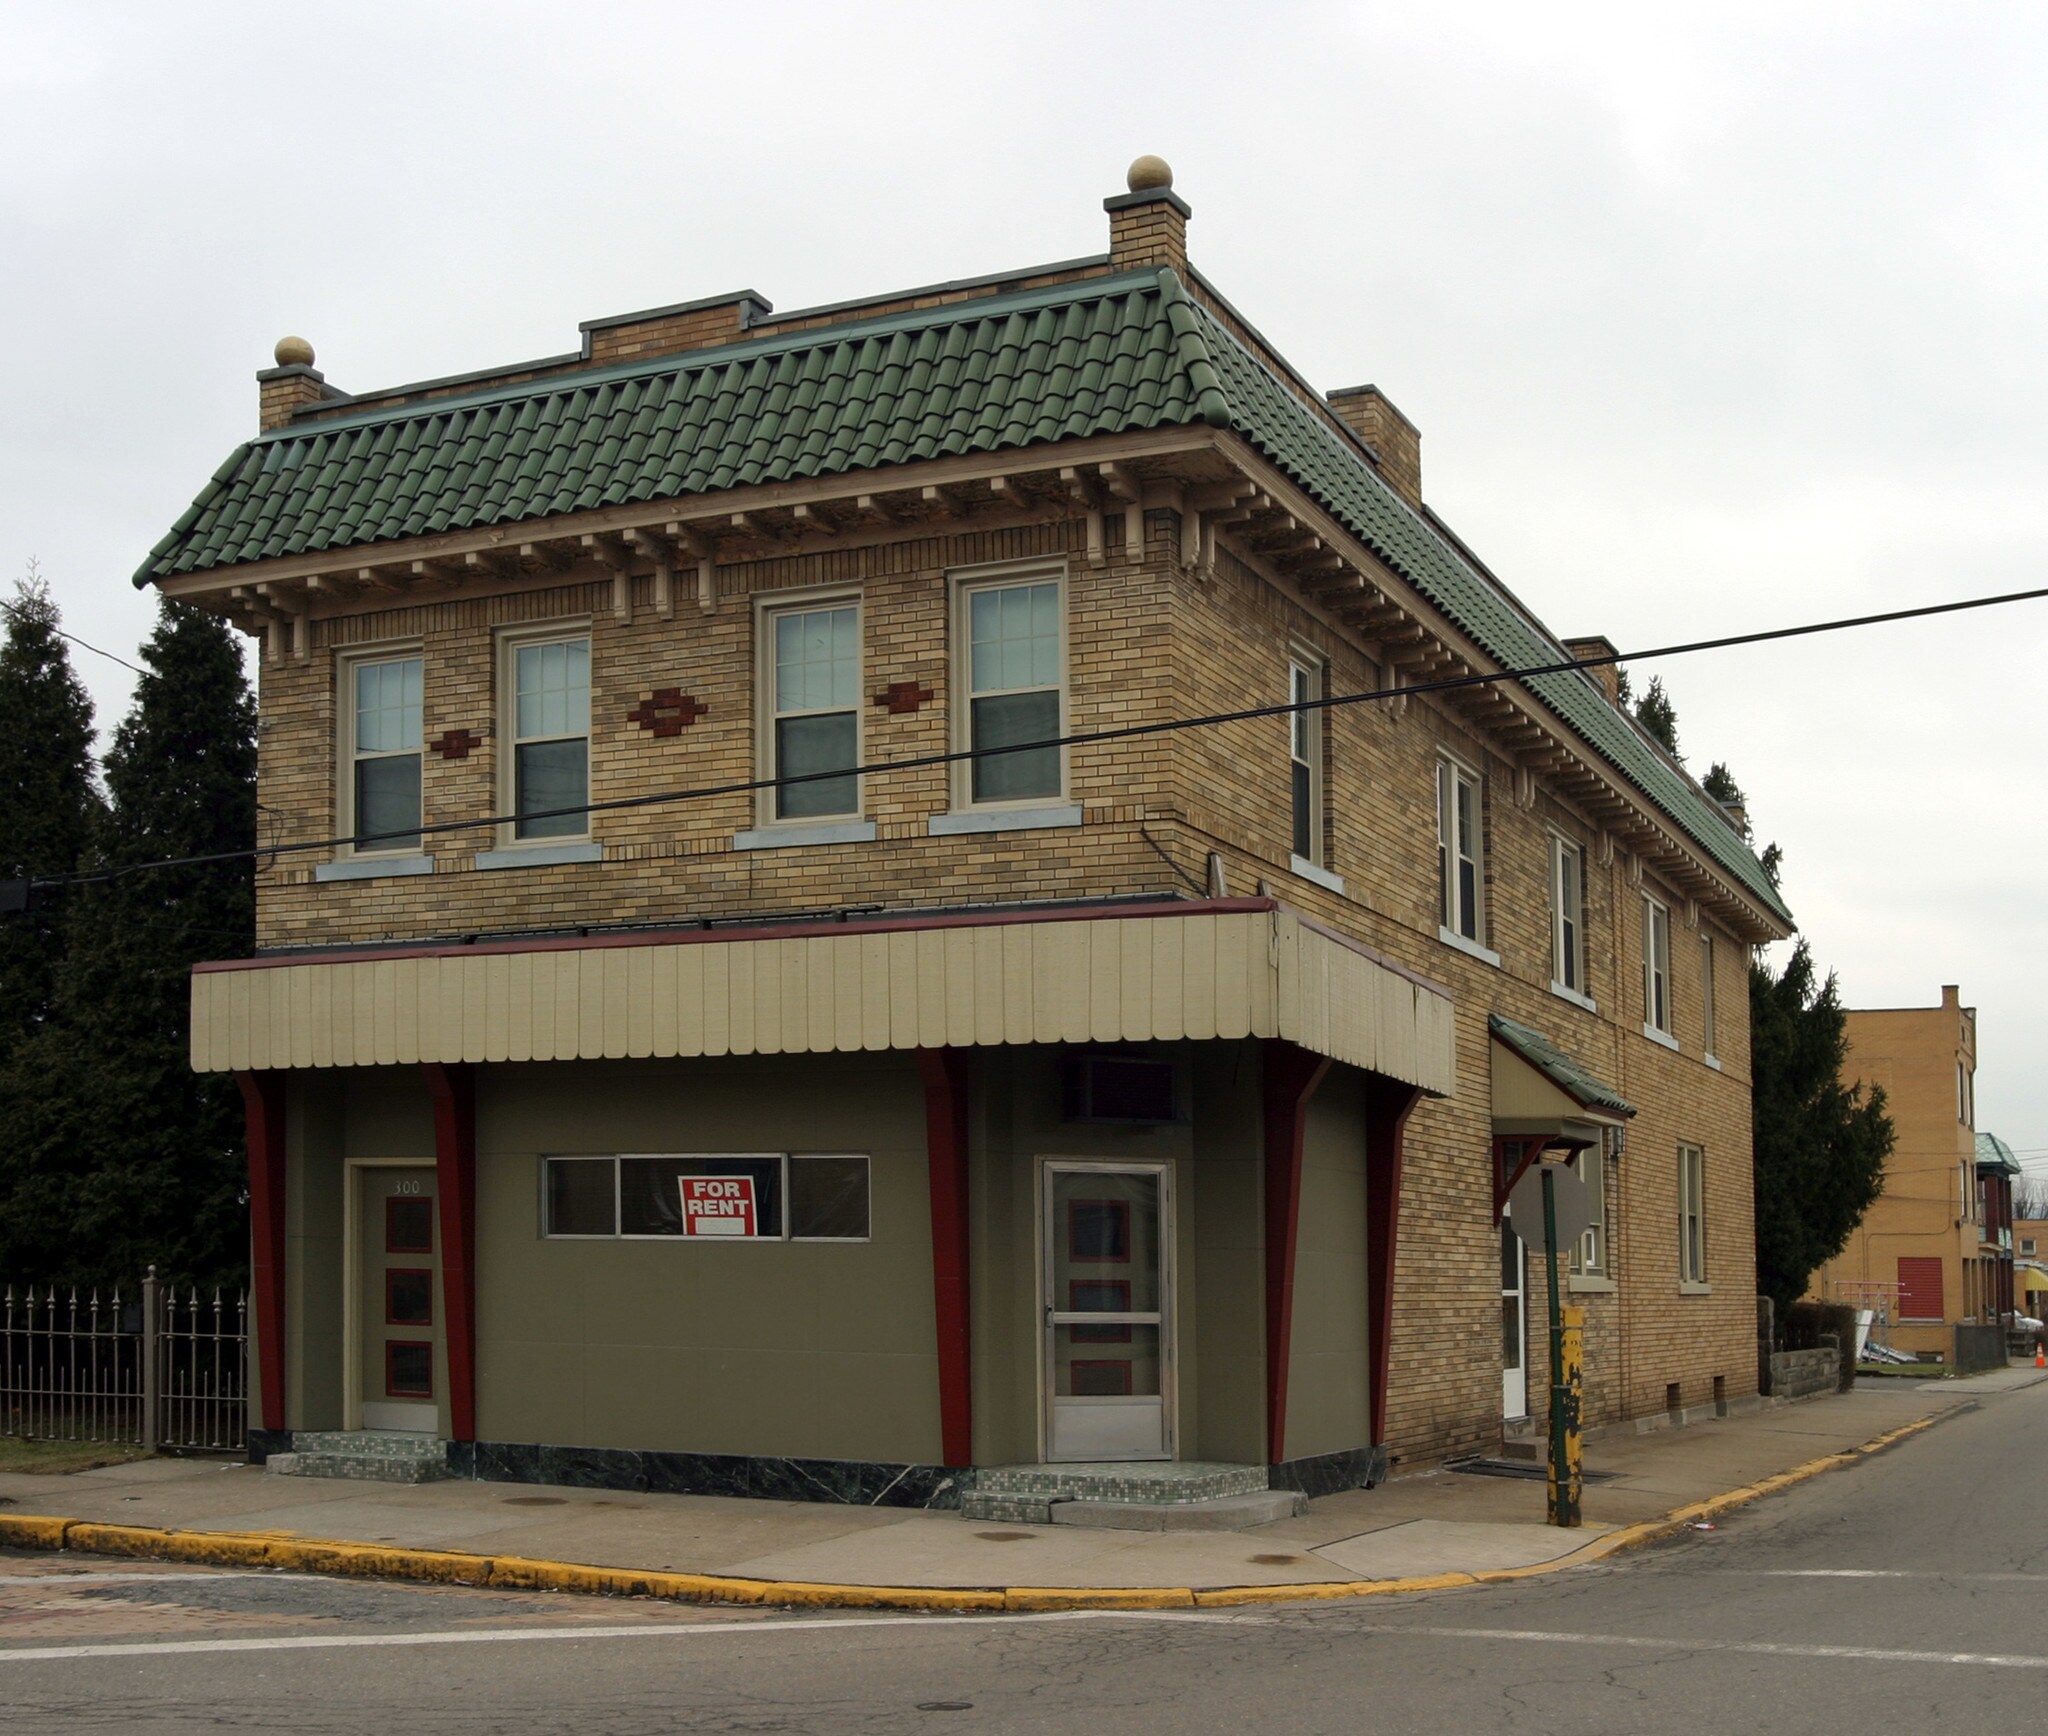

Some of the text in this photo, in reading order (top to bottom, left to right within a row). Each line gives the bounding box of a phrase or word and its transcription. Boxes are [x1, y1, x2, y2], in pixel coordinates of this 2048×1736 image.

[394, 1180, 420, 1195] 300
[692, 1182, 741, 1197] FOR
[687, 1200, 749, 1215] RENT
